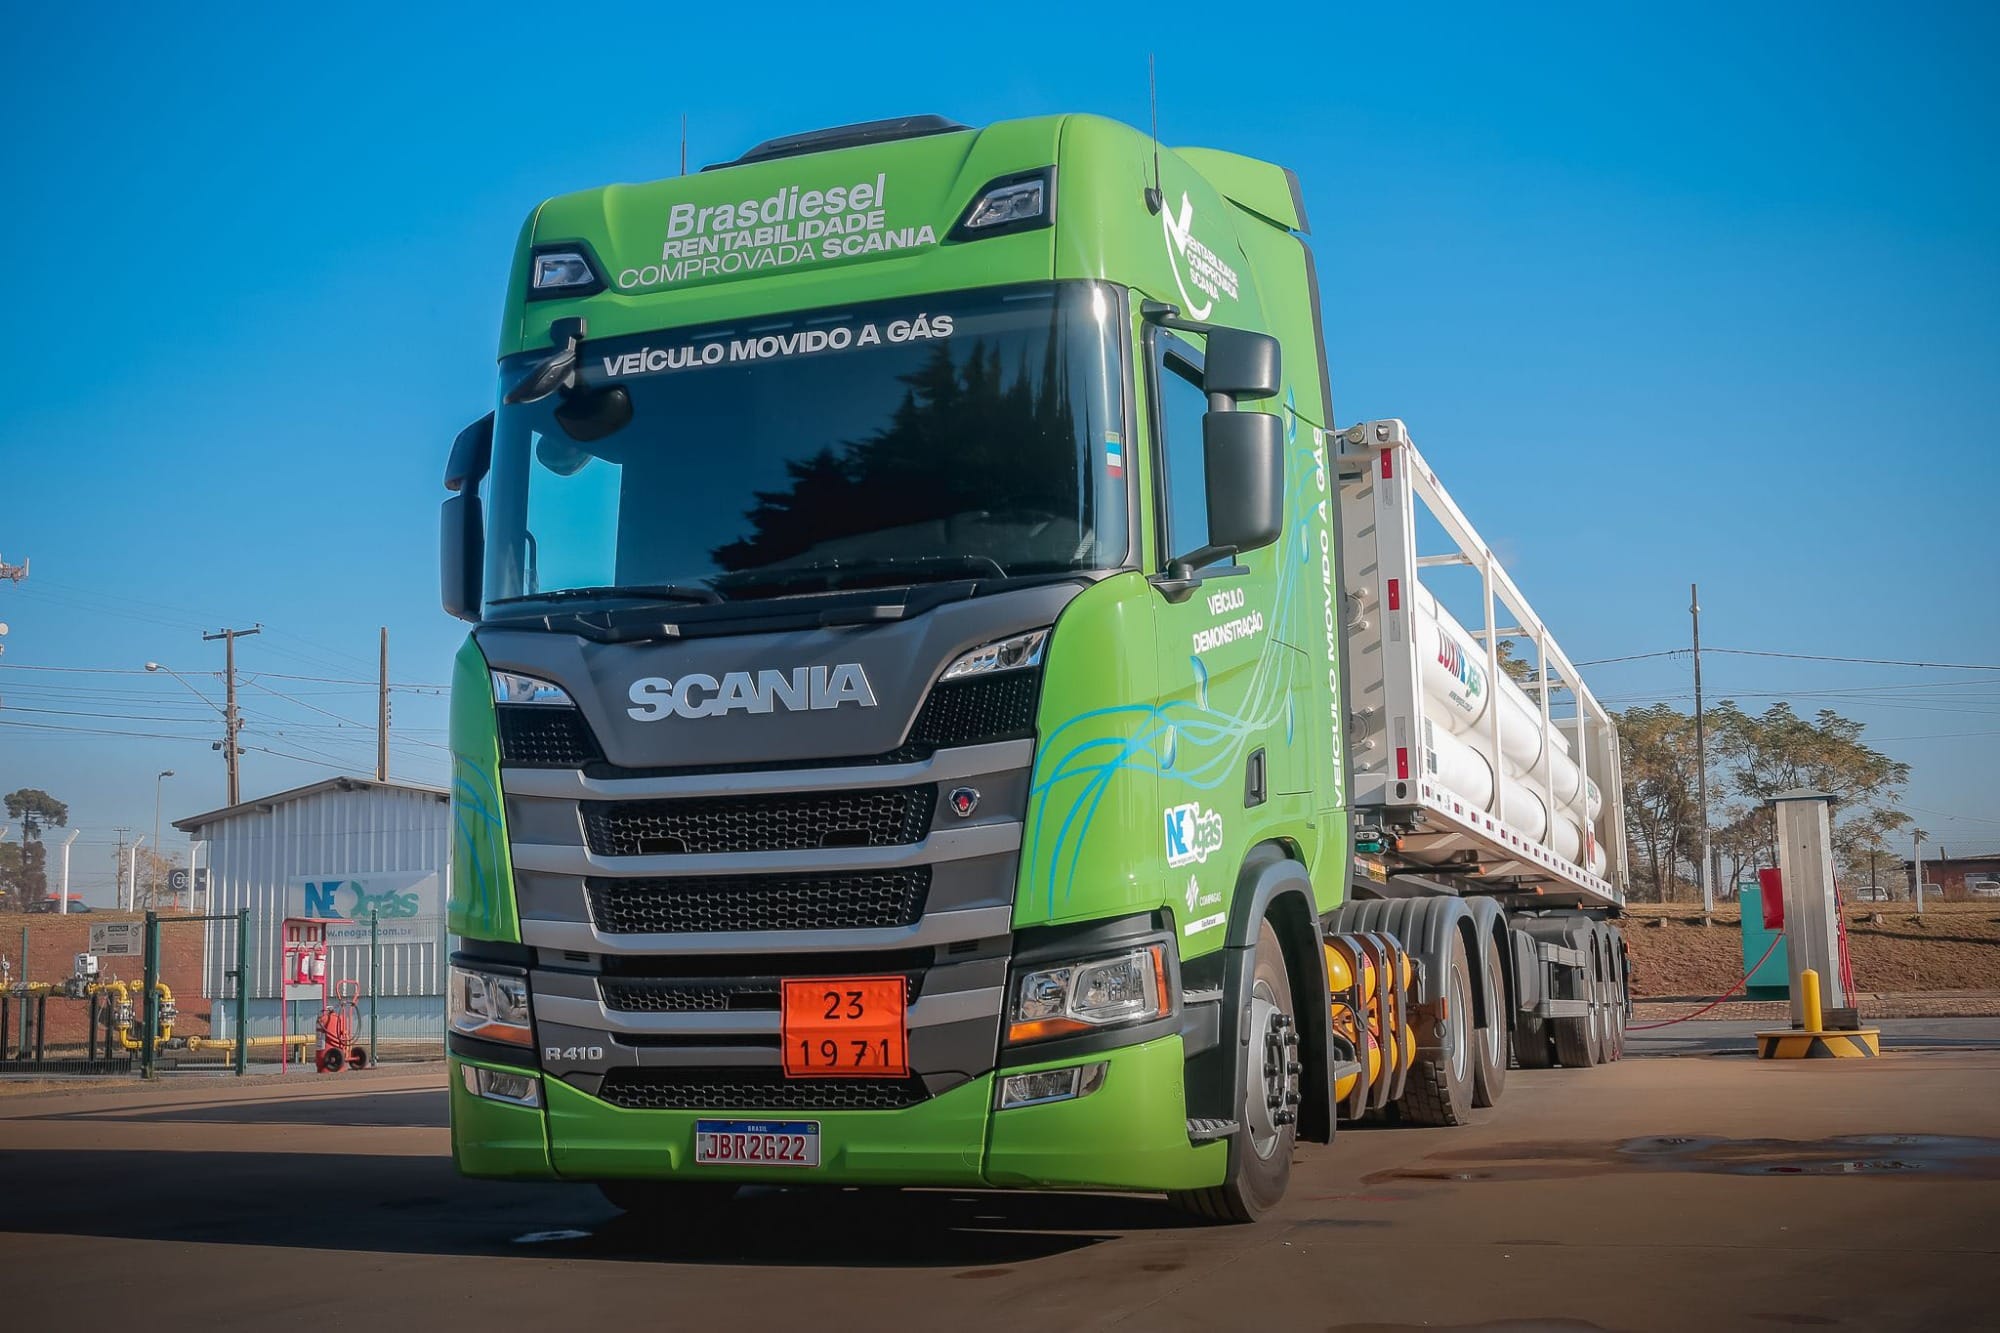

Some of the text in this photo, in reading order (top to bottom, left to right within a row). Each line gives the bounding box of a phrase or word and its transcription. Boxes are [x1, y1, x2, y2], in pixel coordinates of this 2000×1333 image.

[667, 173, 886, 239] Brasdiesel
[662, 210, 885, 261] RENTABILIDADE
[618, 225, 937, 289] COMPROVADA SCANIA
[1190, 267, 1220, 303] SCANIA
[603, 312, 954, 377] VEÍCULO MOVIDO A GÁS
[1318, 499, 1327, 524] A
[1207, 587, 1244, 616] VEÍCULO
[1320, 529, 1334, 662] MOVIDO
[1192, 610, 1264, 655] DEMONSTRAÇÃO
[627, 663, 878, 722] SCANIA
[823, 991, 864, 1020] 23
[800, 1038, 891, 1068] 1971
[706, 1134, 807, 1161] JBR2G22
[747, 1125, 768, 1133] BRASIL
